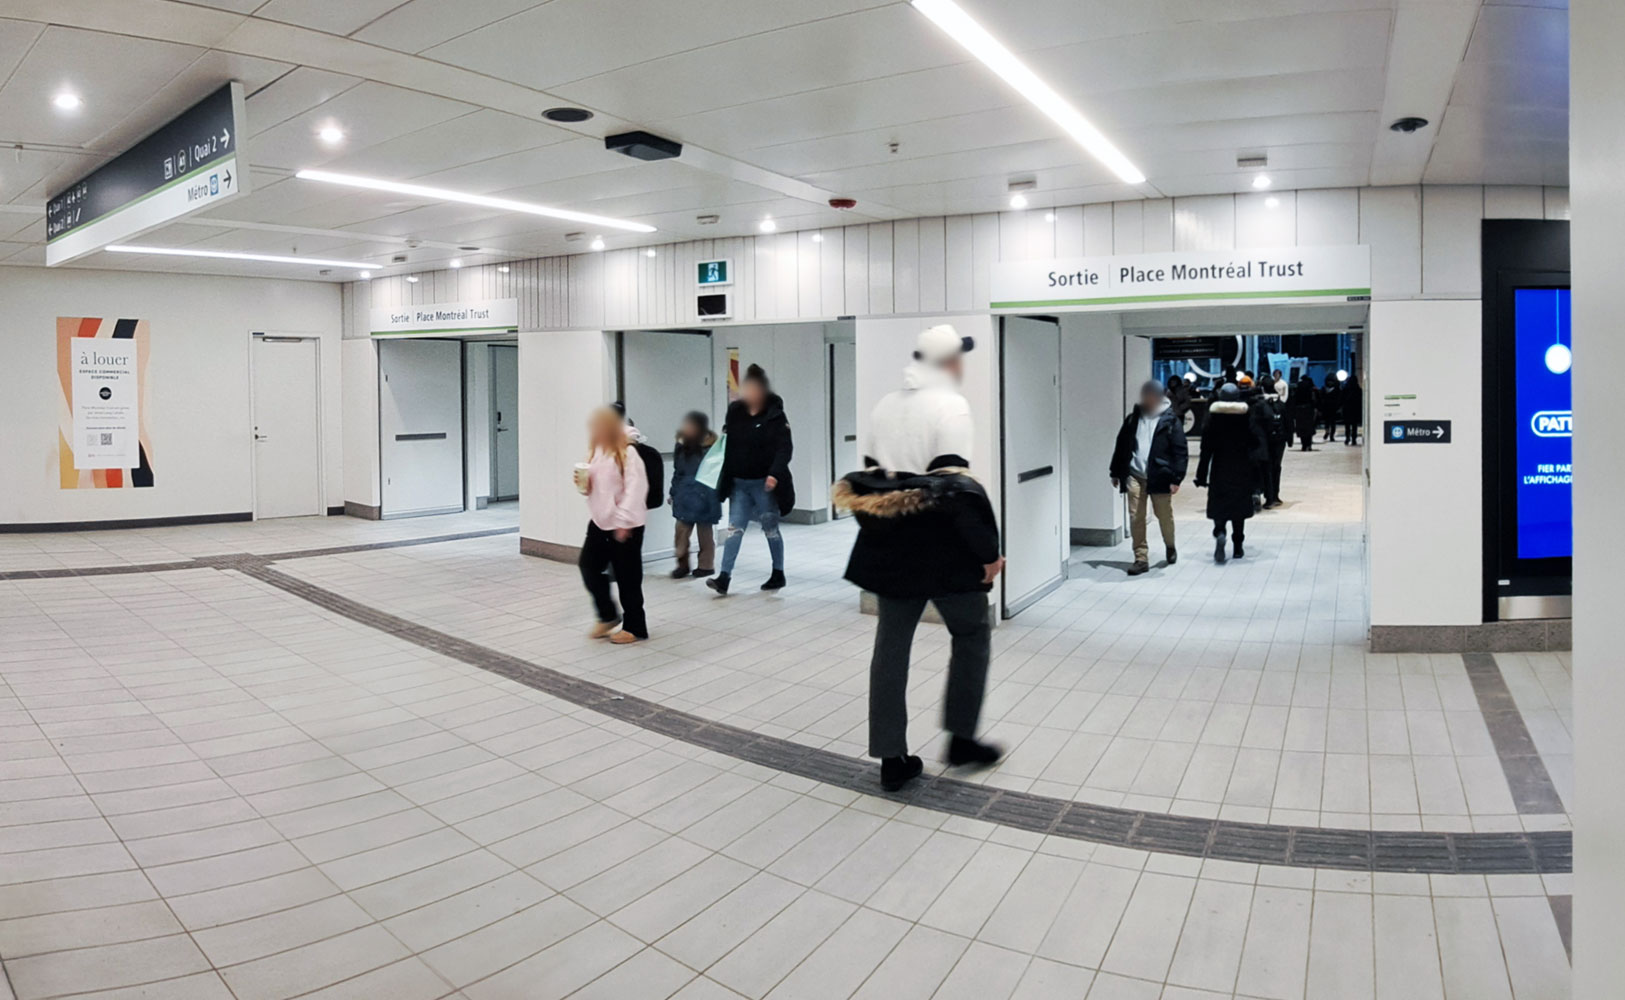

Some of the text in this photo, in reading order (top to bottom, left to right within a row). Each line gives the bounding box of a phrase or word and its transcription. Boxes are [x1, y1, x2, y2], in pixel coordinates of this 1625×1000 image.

[194, 138, 211, 162] Quai
[212, 135, 217, 152] 2
[187, 184, 209, 202] Métro
[1048, 260, 1305, 287] Sortie Place Montréal Trust
[391, 308, 489, 323] Sortie Place Montréal Trust
[81, 351, 129, 365] à louer
[1407, 426, 1431, 437] Métro
[1538, 464, 1555, 473] FIER
